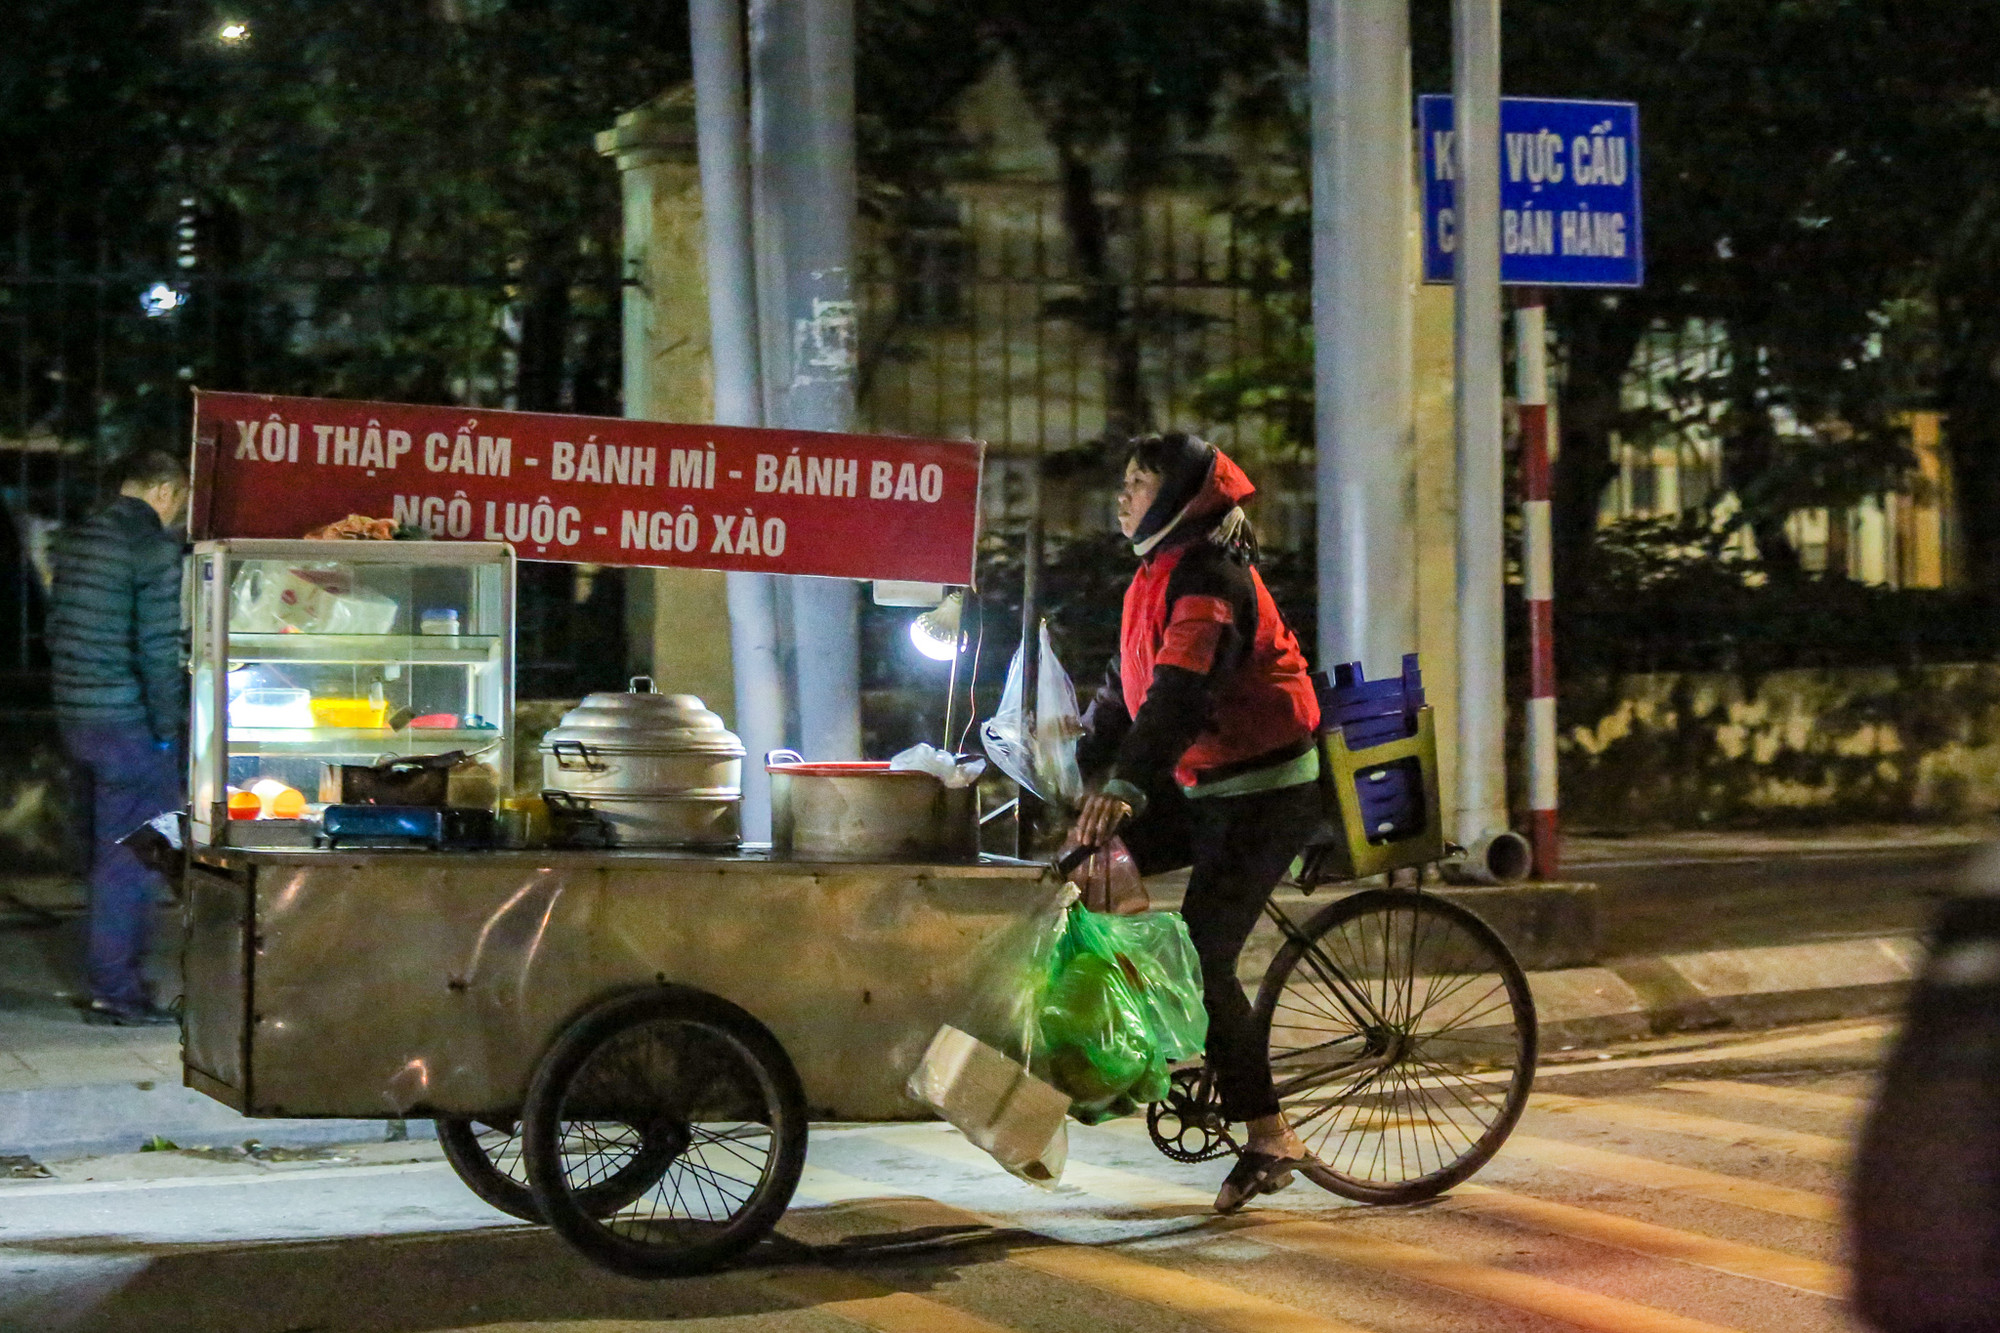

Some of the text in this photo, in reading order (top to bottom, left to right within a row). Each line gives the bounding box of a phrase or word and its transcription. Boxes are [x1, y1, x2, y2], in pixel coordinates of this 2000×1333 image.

[1505, 128, 1565, 192] VỰC
[1502, 200, 1554, 255] BÁN
[1560, 201, 1626, 258] HÀNG
[234, 413, 944, 503] XÔI THẬP CẨM - BÁNH MÌ - BÁNH BAO
[392, 489, 787, 557] NGÔ LUỘC - NGÔ XÀO
